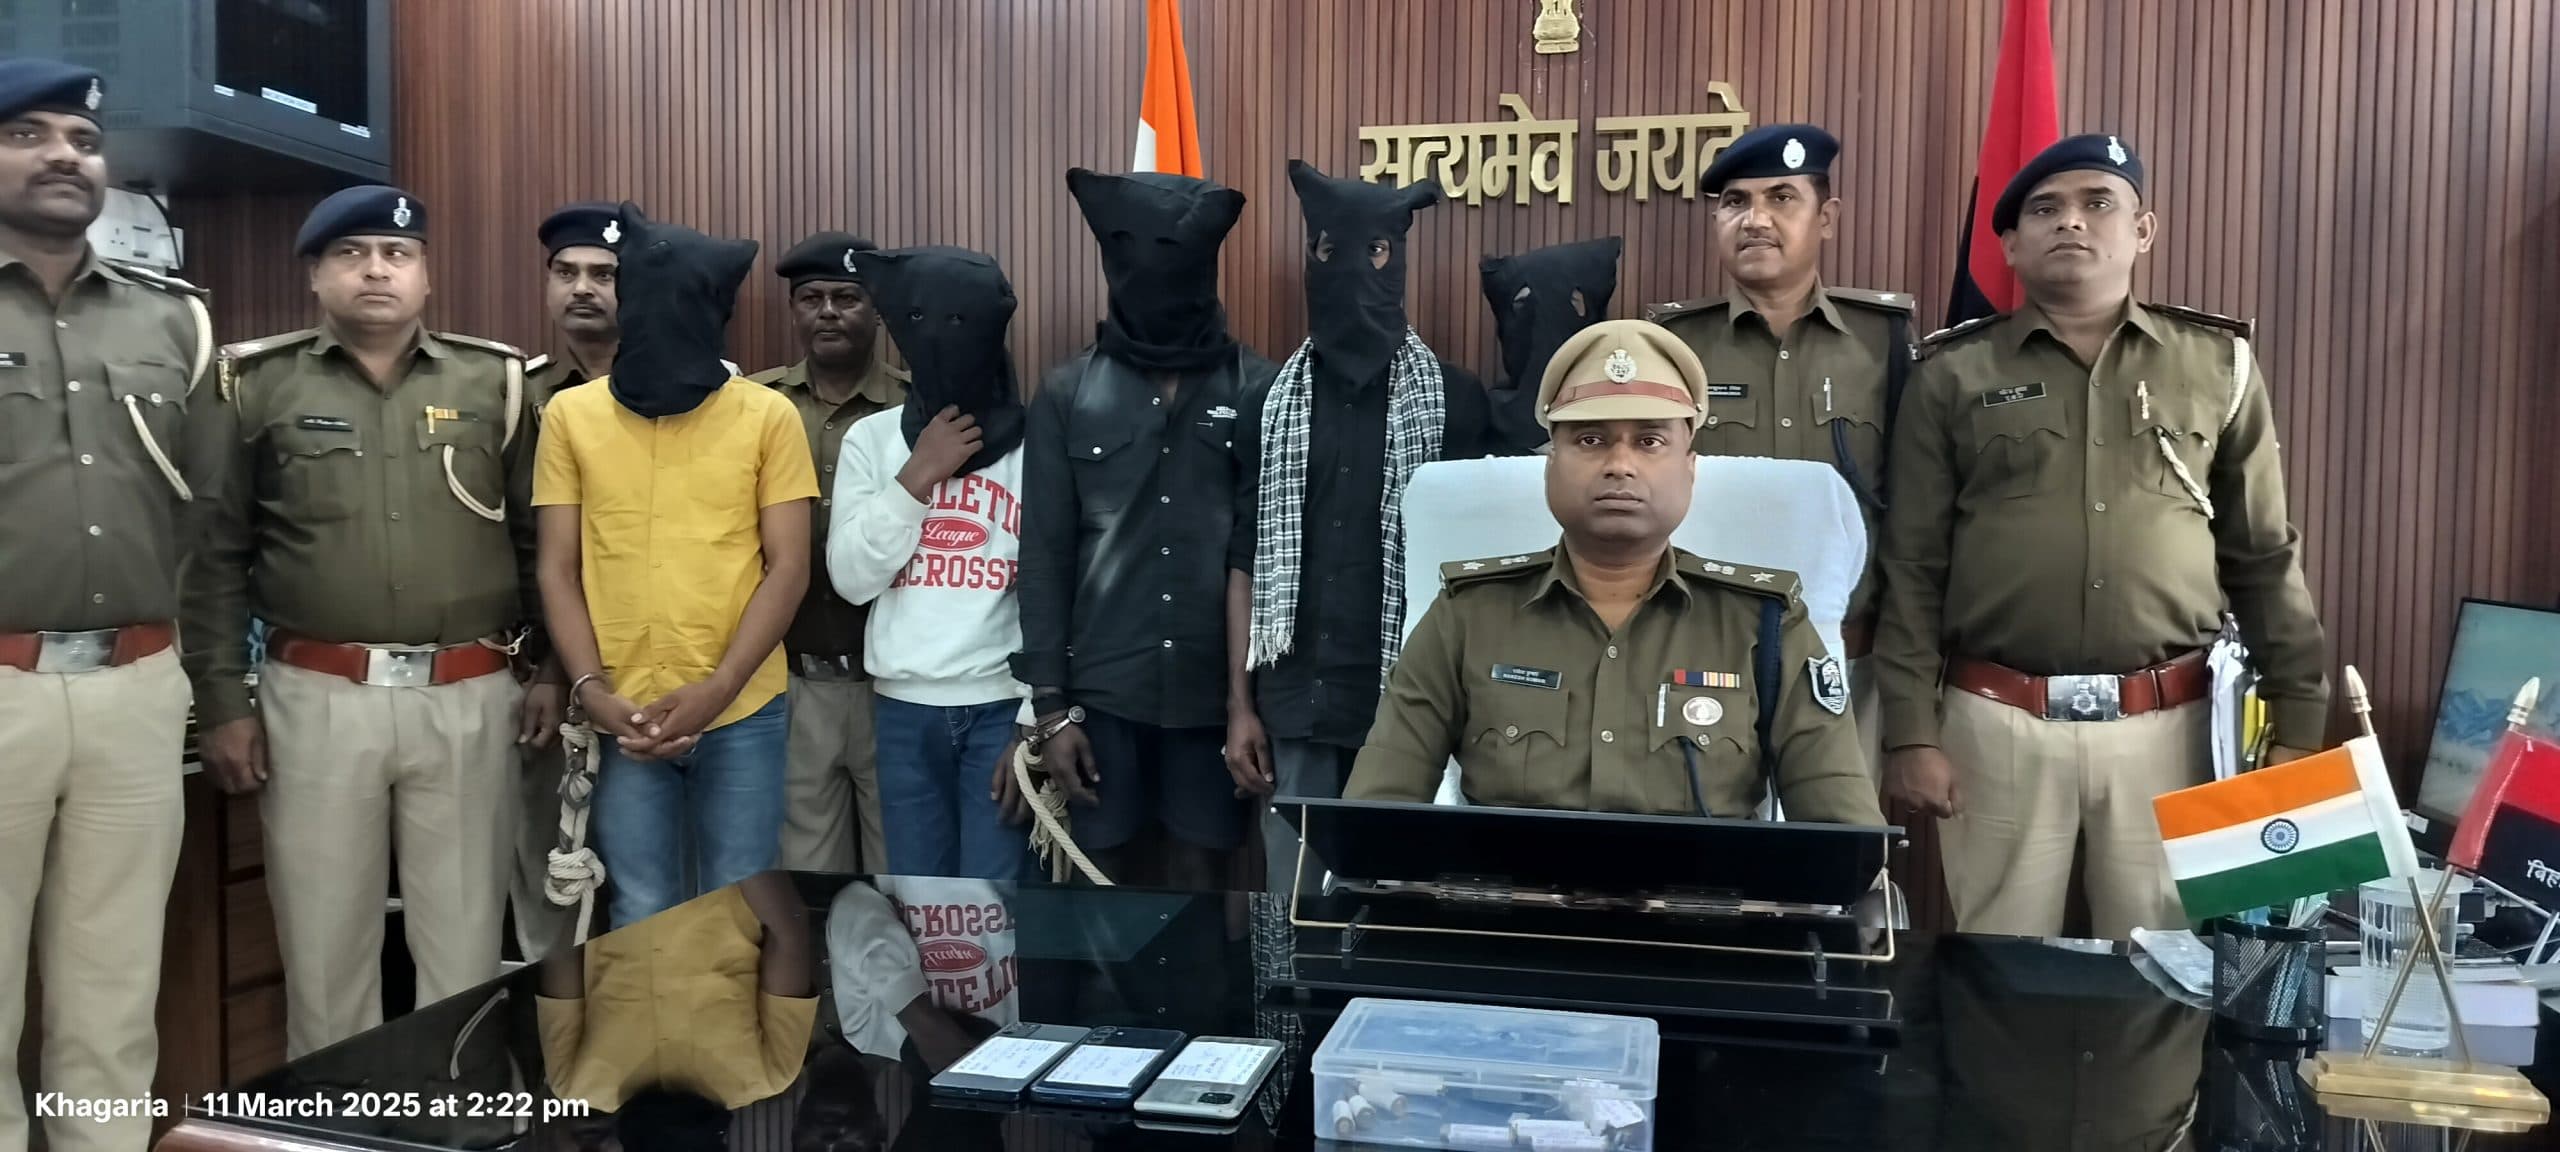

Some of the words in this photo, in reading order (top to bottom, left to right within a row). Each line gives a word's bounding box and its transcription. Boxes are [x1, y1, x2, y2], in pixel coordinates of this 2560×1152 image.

[1359, 93, 1578, 206] सत्यमेव
[930, 473, 1021, 538] LETI
[923, 521, 979, 547] League
[2526, 859, 2560, 888] बिह
